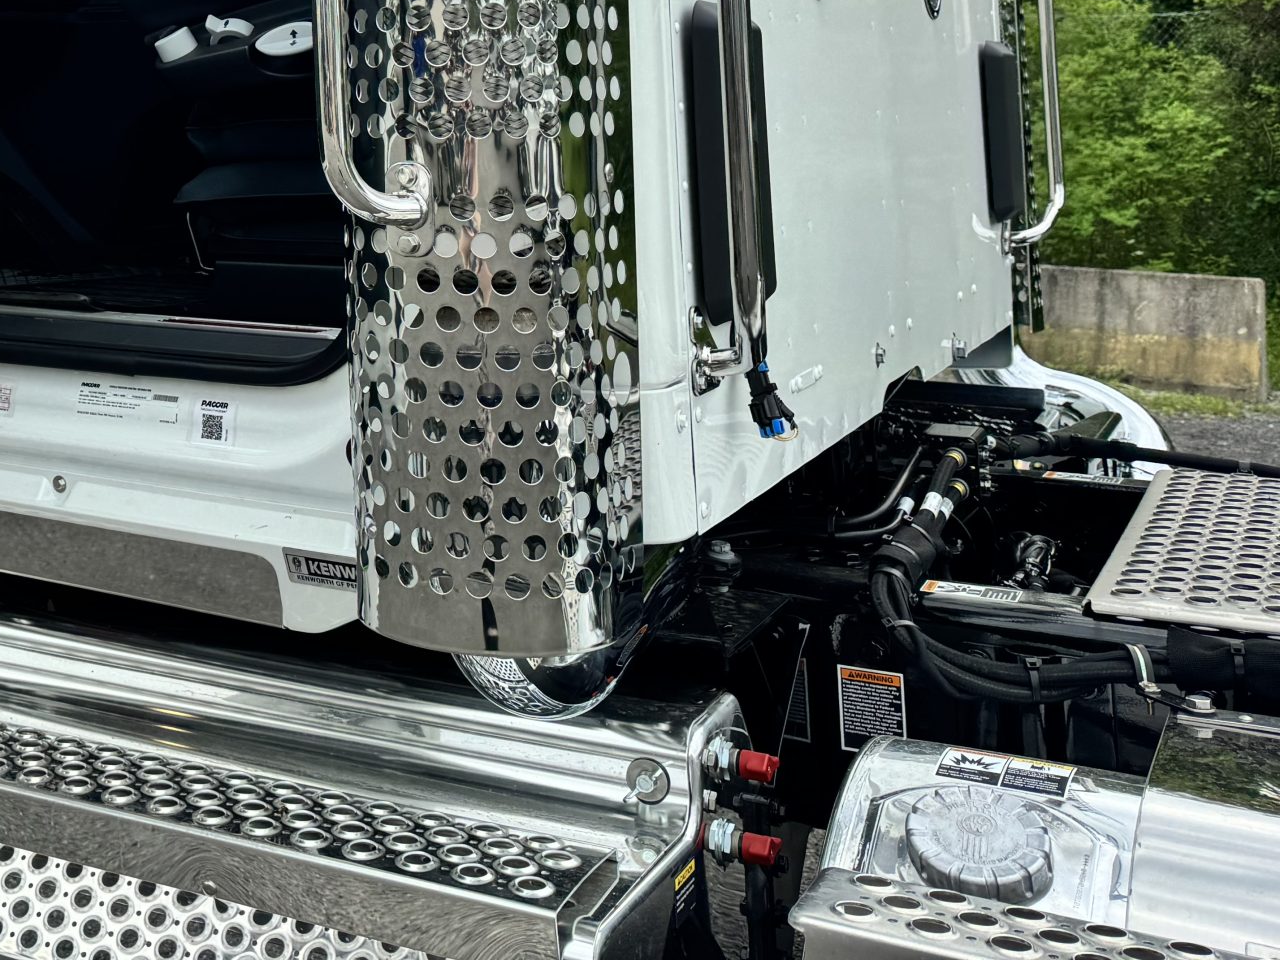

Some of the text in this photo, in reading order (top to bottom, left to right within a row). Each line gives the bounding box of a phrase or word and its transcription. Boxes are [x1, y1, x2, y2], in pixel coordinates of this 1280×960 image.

[201, 400, 229, 410] PACCAR
[308, 560, 357, 581] KENW
[296, 575, 335, 586] KENWORTH
[854, 672, 894, 684] WARNING
